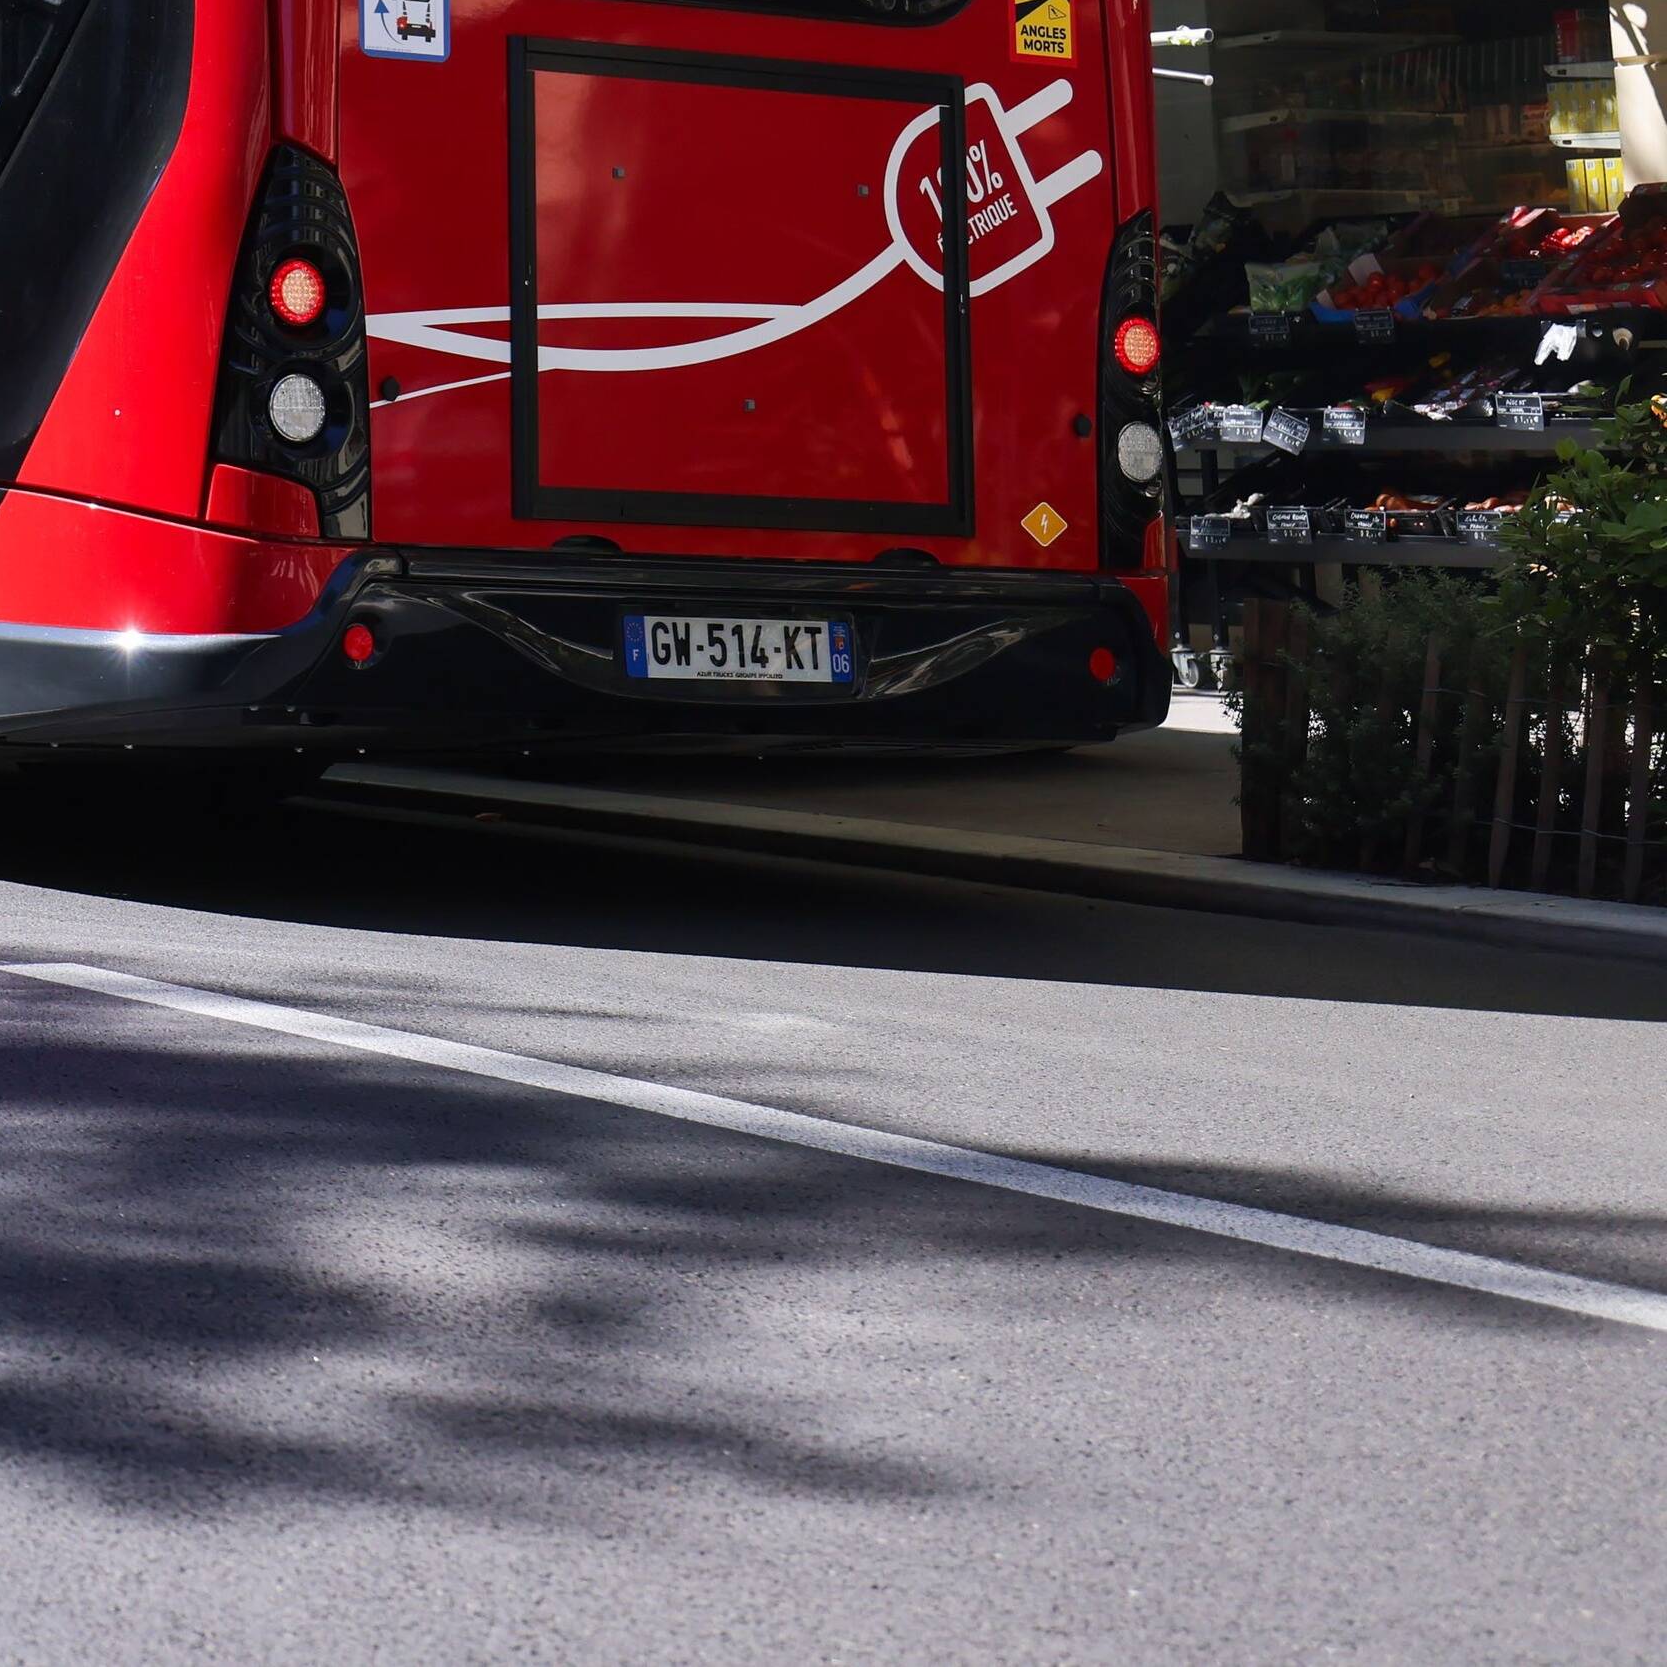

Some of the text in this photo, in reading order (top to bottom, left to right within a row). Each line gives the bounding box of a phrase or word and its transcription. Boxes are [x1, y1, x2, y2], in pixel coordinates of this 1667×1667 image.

[1020, 24, 1067, 40] ANGLES
[1023, 38, 1064, 53] MORTS
[919, 139, 1004, 225] 10%
[632, 649, 640, 662] F
[651, 622, 822, 670] GW-514-KT
[832, 653, 850, 673] 06
